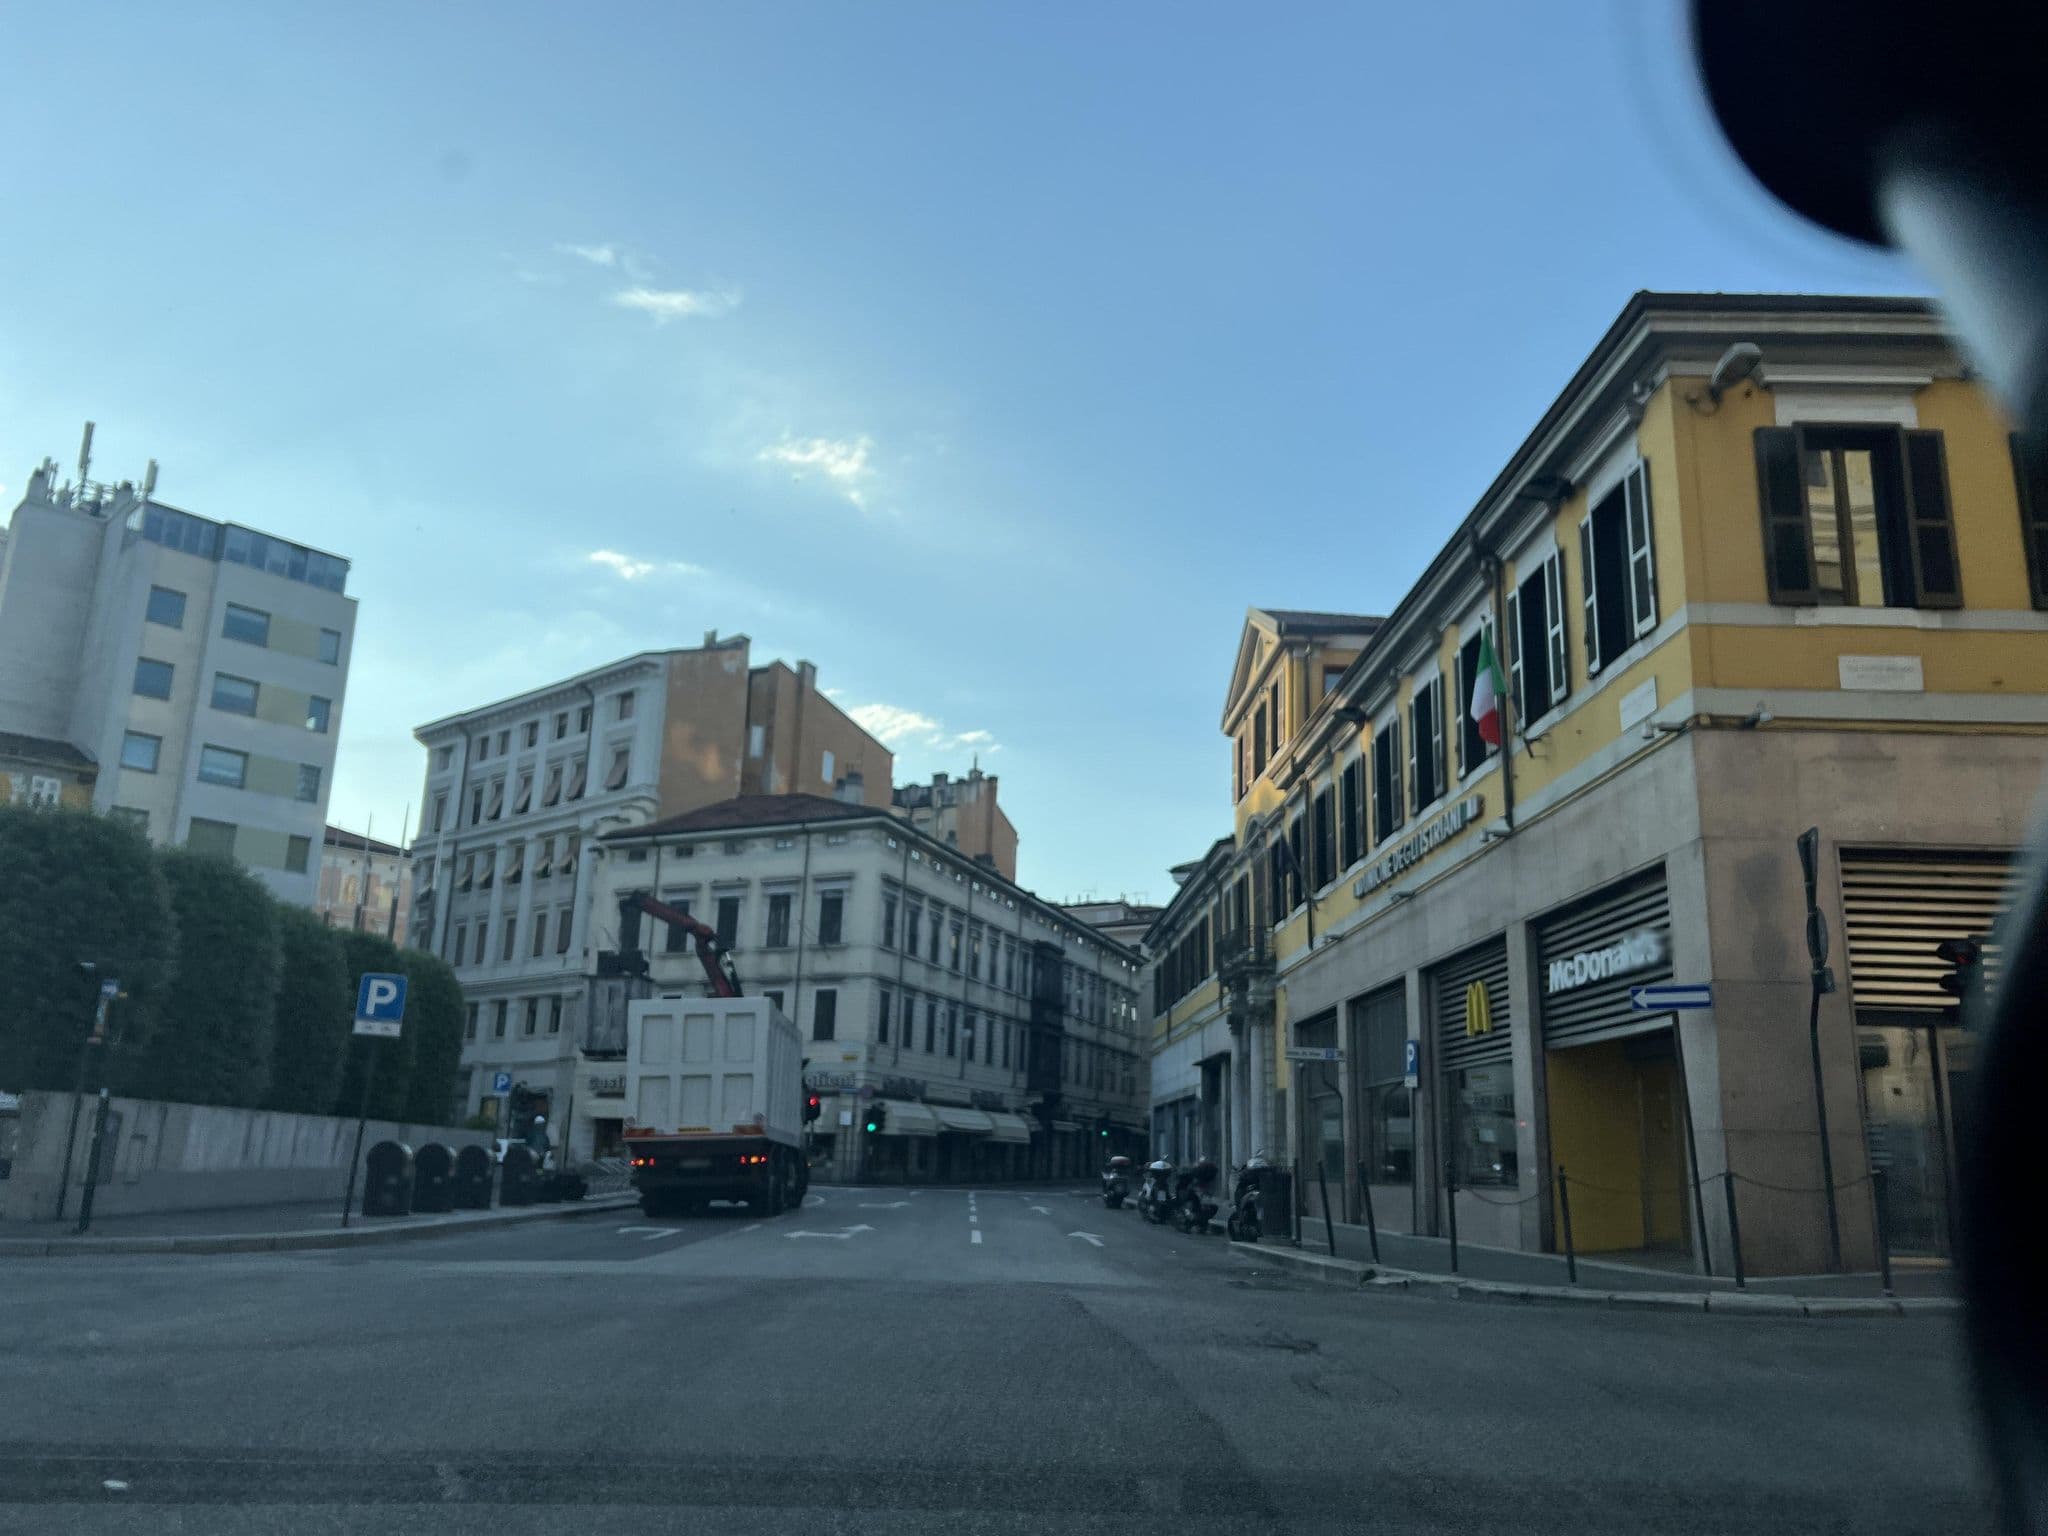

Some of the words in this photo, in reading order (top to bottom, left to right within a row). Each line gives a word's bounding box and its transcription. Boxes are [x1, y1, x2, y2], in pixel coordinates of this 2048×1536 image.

[1393, 834, 1420, 873] DEGLI
[1420, 803, 1461, 854] ISTRIANI
[366, 979, 397, 1015] P
[1406, 1042, 1415, 1072] P
[496, 1073, 508, 1089] P
